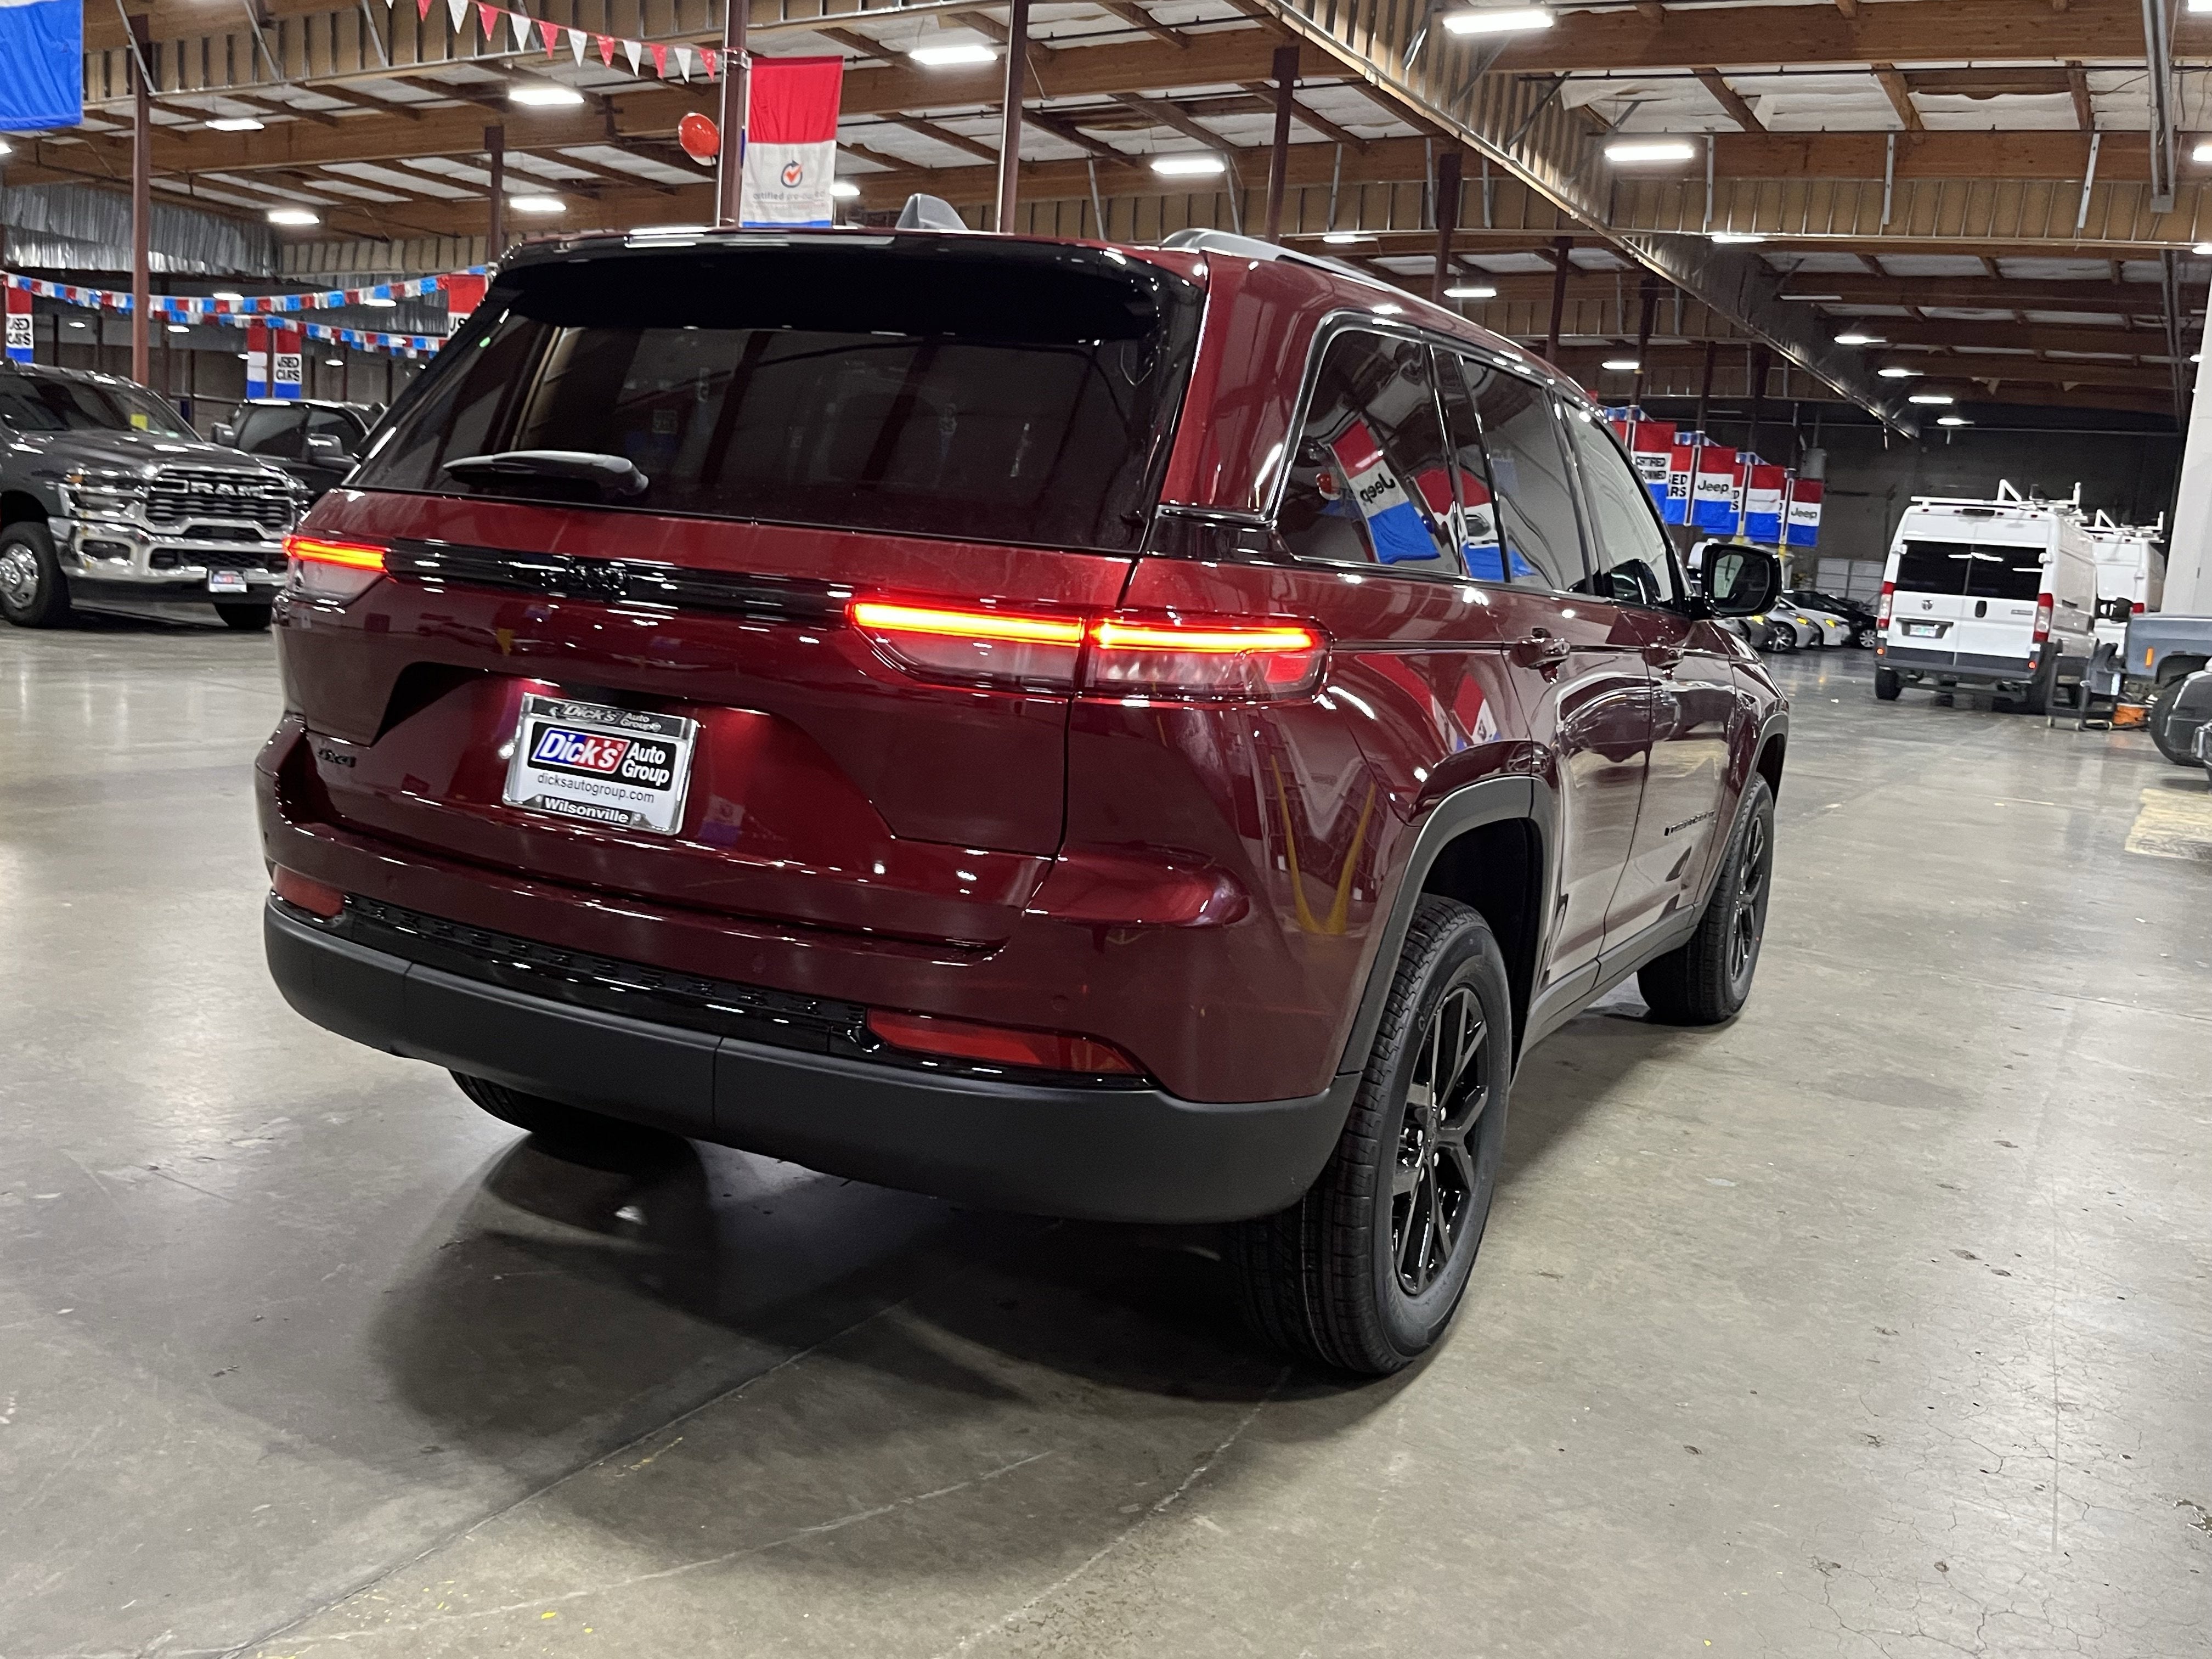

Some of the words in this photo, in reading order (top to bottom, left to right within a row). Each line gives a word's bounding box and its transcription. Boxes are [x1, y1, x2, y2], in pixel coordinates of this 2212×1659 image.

[190, 481, 265, 499] RAM
[1697, 480, 1729, 494] Jeep
[1791, 507, 1818, 520] Jeep
[563, 705, 617, 722] Dick's
[625, 713, 650, 723] Auto
[539, 732, 619, 768] Dick's
[626, 742, 667, 765] Auto
[622, 759, 670, 787] Group
[537, 772, 655, 803] dicksautogroup.com
[545, 797, 629, 823] Wilsonville
